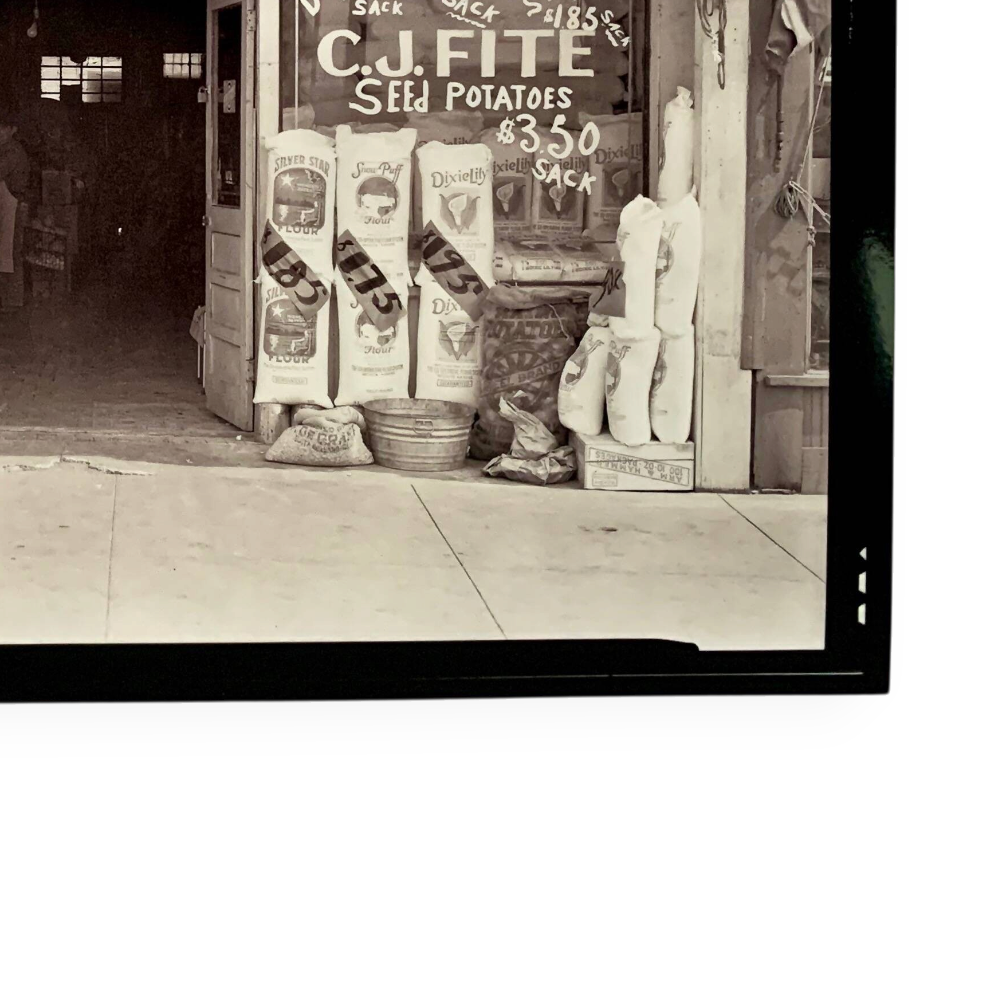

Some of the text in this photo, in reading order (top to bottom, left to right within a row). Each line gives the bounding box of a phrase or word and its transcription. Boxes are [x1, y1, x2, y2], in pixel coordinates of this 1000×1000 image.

[352, 0, 403, 16] SACK
[601, 10, 631, 47] SACK
[436, 29, 596, 78] FITE
[446, 81, 573, 111] POTATOES
[496, 113, 600, 159] $3.50
[274, 154, 330, 177] SILVER STAR
[532, 158, 597, 196] SACK
[278, 225, 319, 235] FLOUR
[268, 354, 309, 364] FLOUR
[660, 472, 683, 483] ARM
